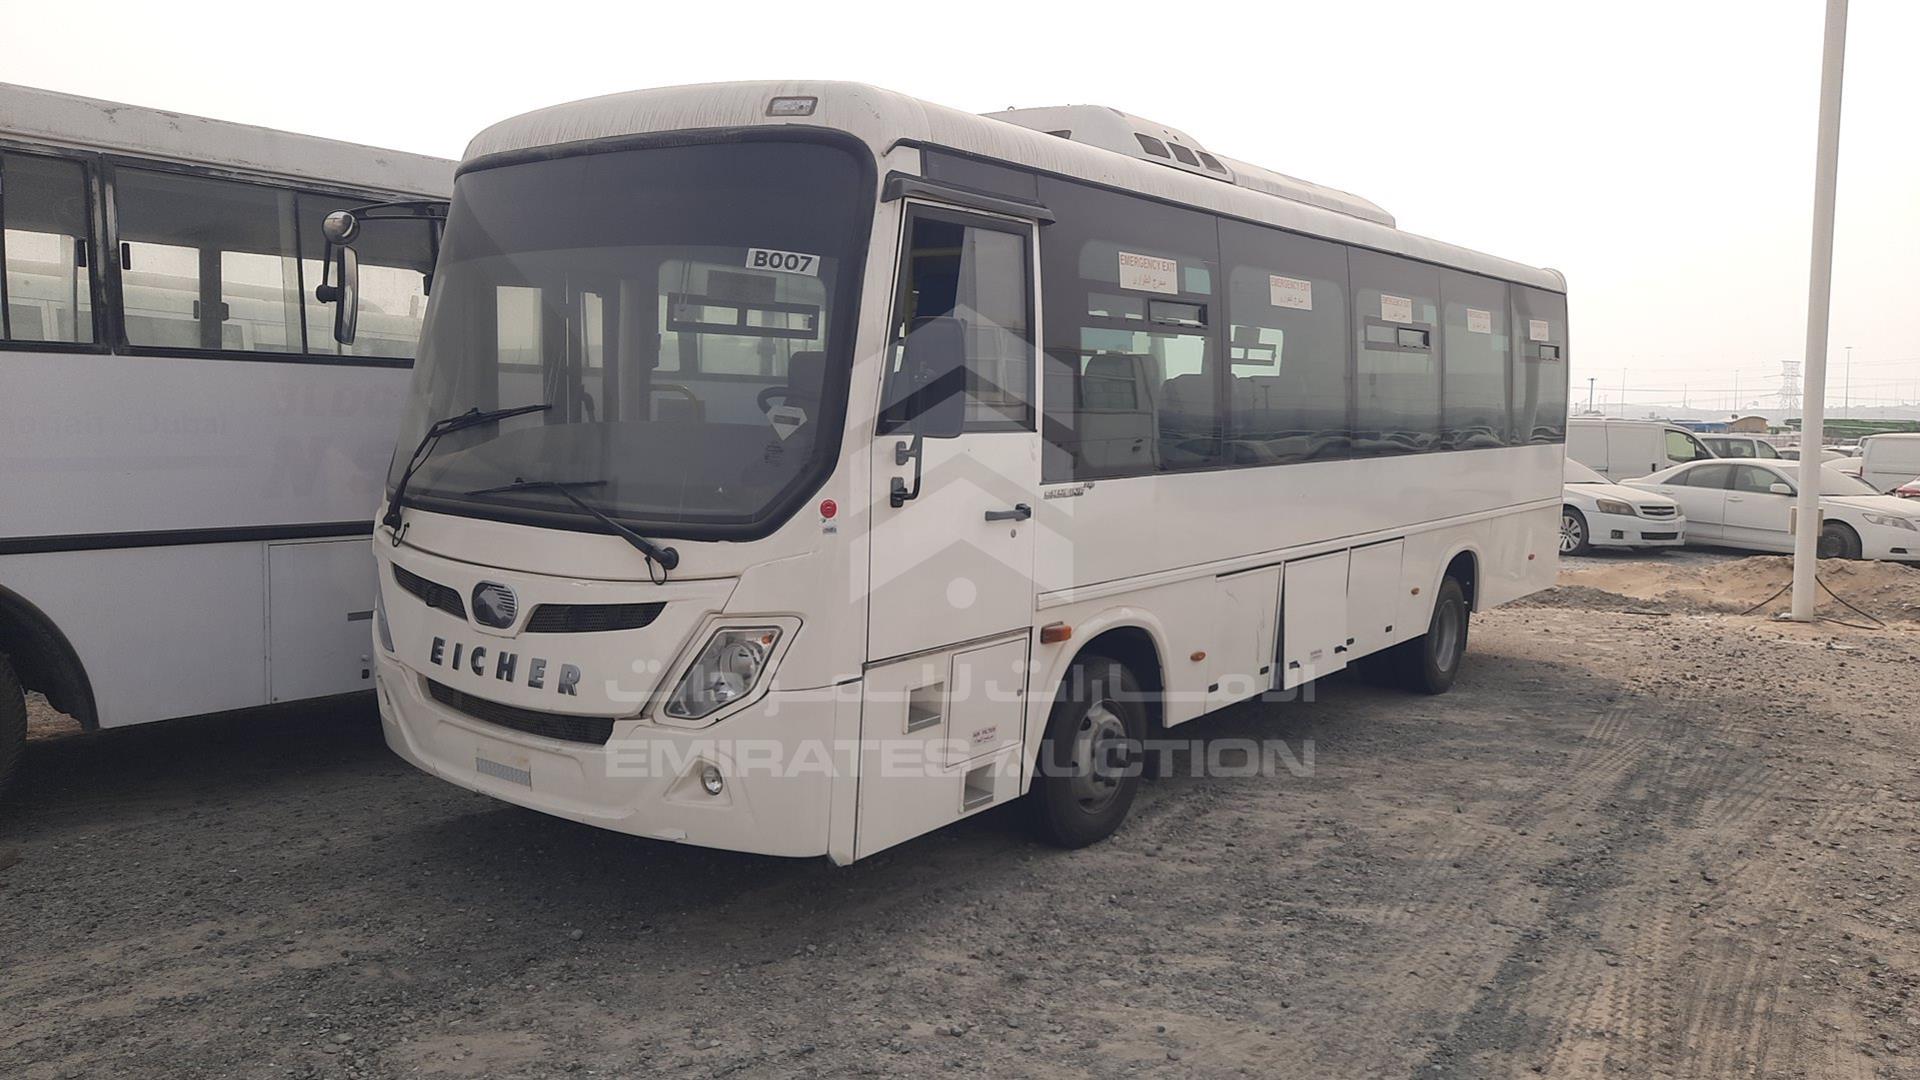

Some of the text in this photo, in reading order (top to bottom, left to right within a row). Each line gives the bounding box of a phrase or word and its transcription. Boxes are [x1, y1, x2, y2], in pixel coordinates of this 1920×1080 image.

[754, 251, 813, 272] B007
[1120, 254, 1176, 273] EMERGENCY EXIT
[430, 636, 581, 697] EICHER
